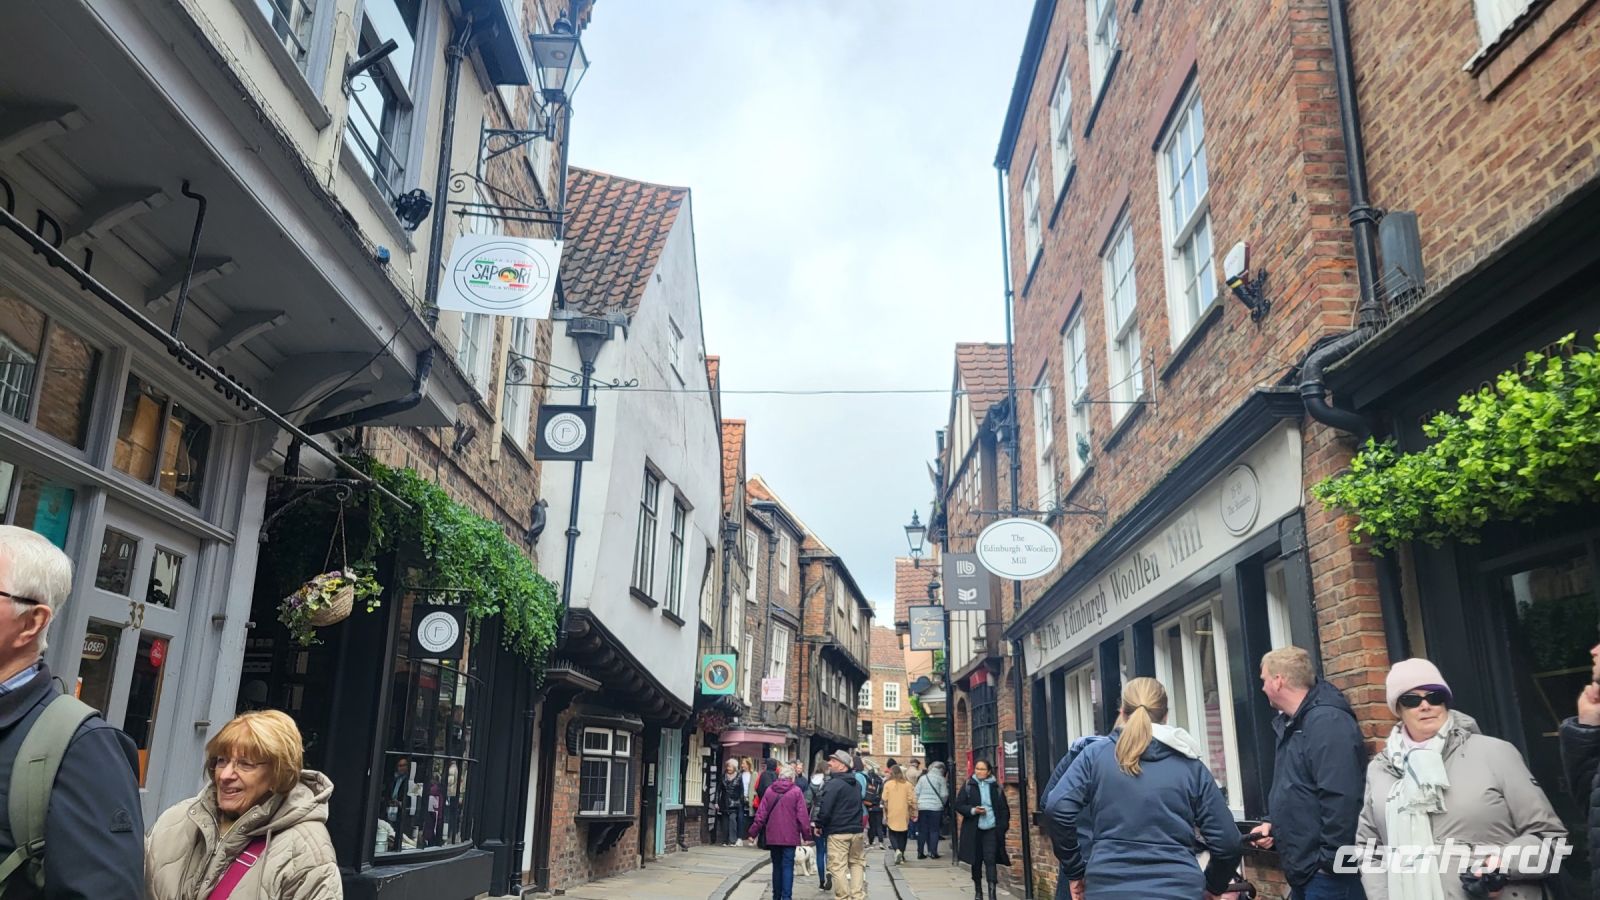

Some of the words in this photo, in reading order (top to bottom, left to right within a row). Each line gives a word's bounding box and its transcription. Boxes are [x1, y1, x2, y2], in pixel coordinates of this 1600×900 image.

[983, 544, 1020, 554] Edinburgh
[1024, 544, 1054, 553] Woollen
[1047, 622, 1061, 650] The
[1062, 584, 1108, 640] Edinburgh
[1109, 551, 1160, 605] Woollen
[1167, 507, 1204, 568] Mill
[125, 601, 145, 631] 33
